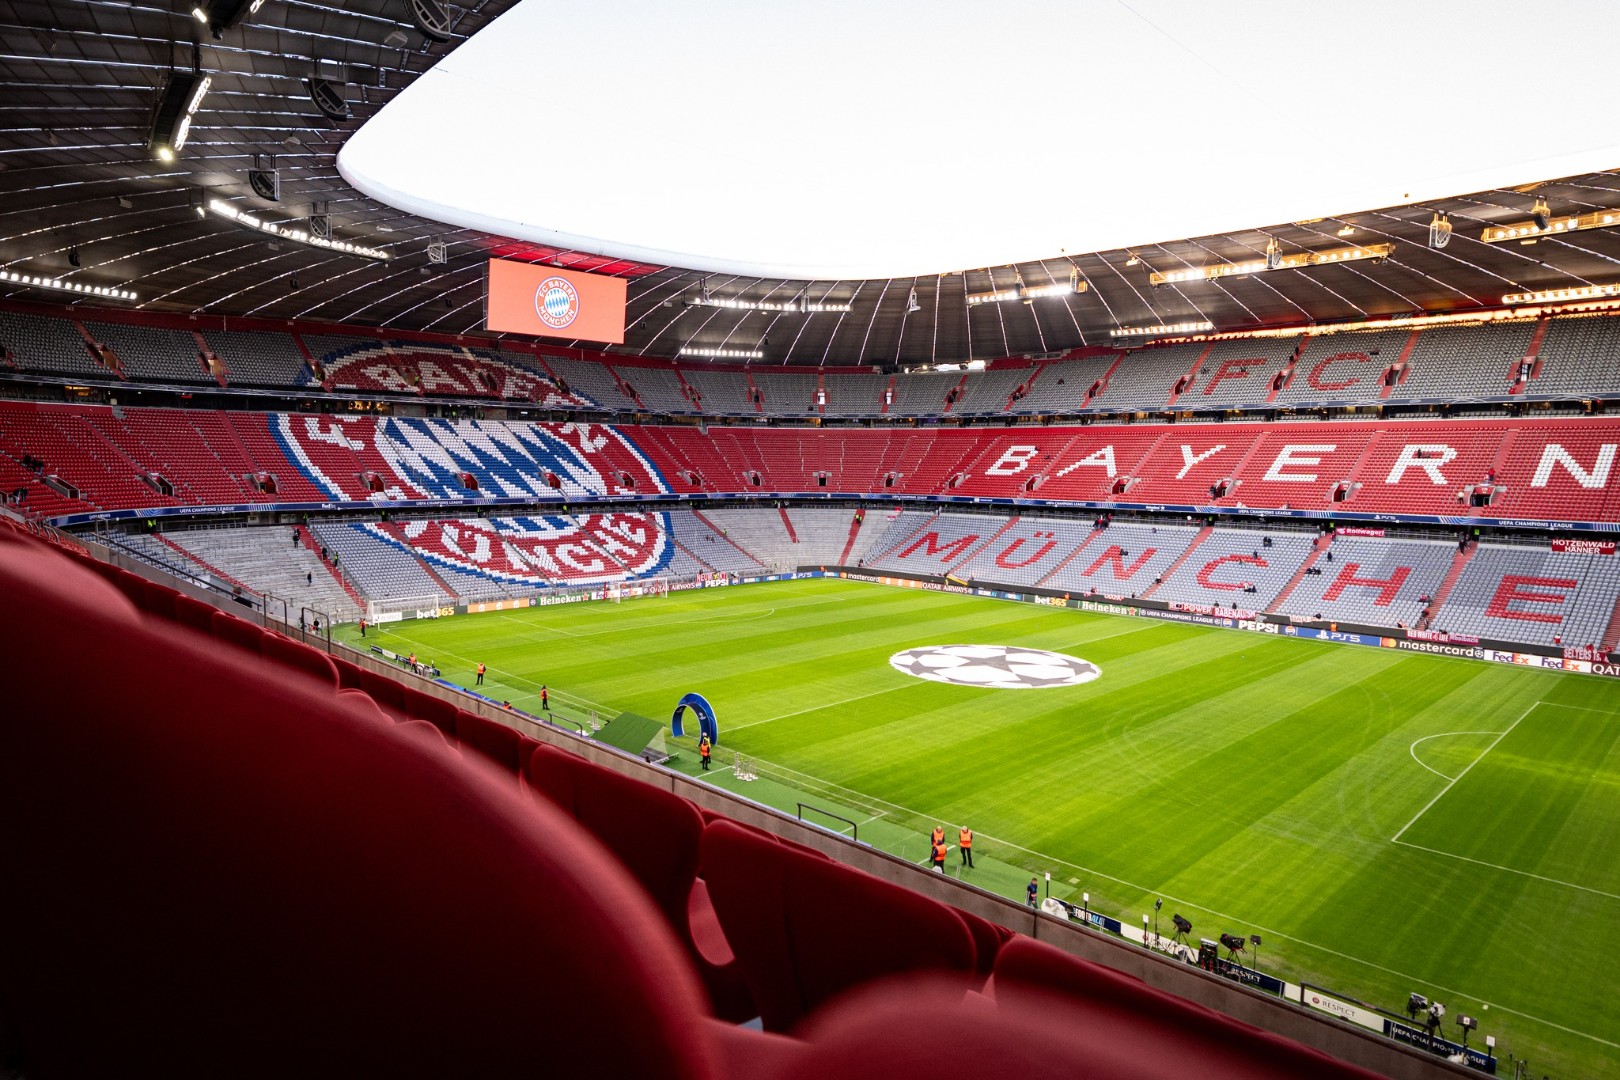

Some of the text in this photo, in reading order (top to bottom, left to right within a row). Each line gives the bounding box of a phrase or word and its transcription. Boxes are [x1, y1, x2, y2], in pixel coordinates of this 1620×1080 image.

[538, 281, 575, 301] FC BAYERN
[984, 444, 1619, 488] BAYERN
[1552, 539, 1615, 549] HOTZENWALD
[705, 578, 729, 588] PEPSI
[848, 573, 880, 583] mastercard
[671, 582, 695, 591] AIRWAYS
[922, 582, 941, 591] QATAR
[942, 585, 968, 594] AIRWAYS
[540, 594, 581, 606] Heineken
[1035, 595, 1066, 607] bet365
[416, 607, 454, 619] bet365
[1082, 601, 1127, 615] Heineken
[1184, 604, 1212, 614] POWER
[1161, 612, 1192, 621] CHAMPIONS
[1192, 616, 1213, 624] LEAGUE
[1238, 620, 1279, 634] PEPSI
[1331, 632, 1361, 642] PS5
[1399, 640, 1474, 657] mastercard
[1492, 651, 1529, 665] FedEx
[1541, 657, 1580, 671] FedEx
[1322, 1000, 1356, 1018] RESPECT
[1392, 1027, 1411, 1039] UEFA
